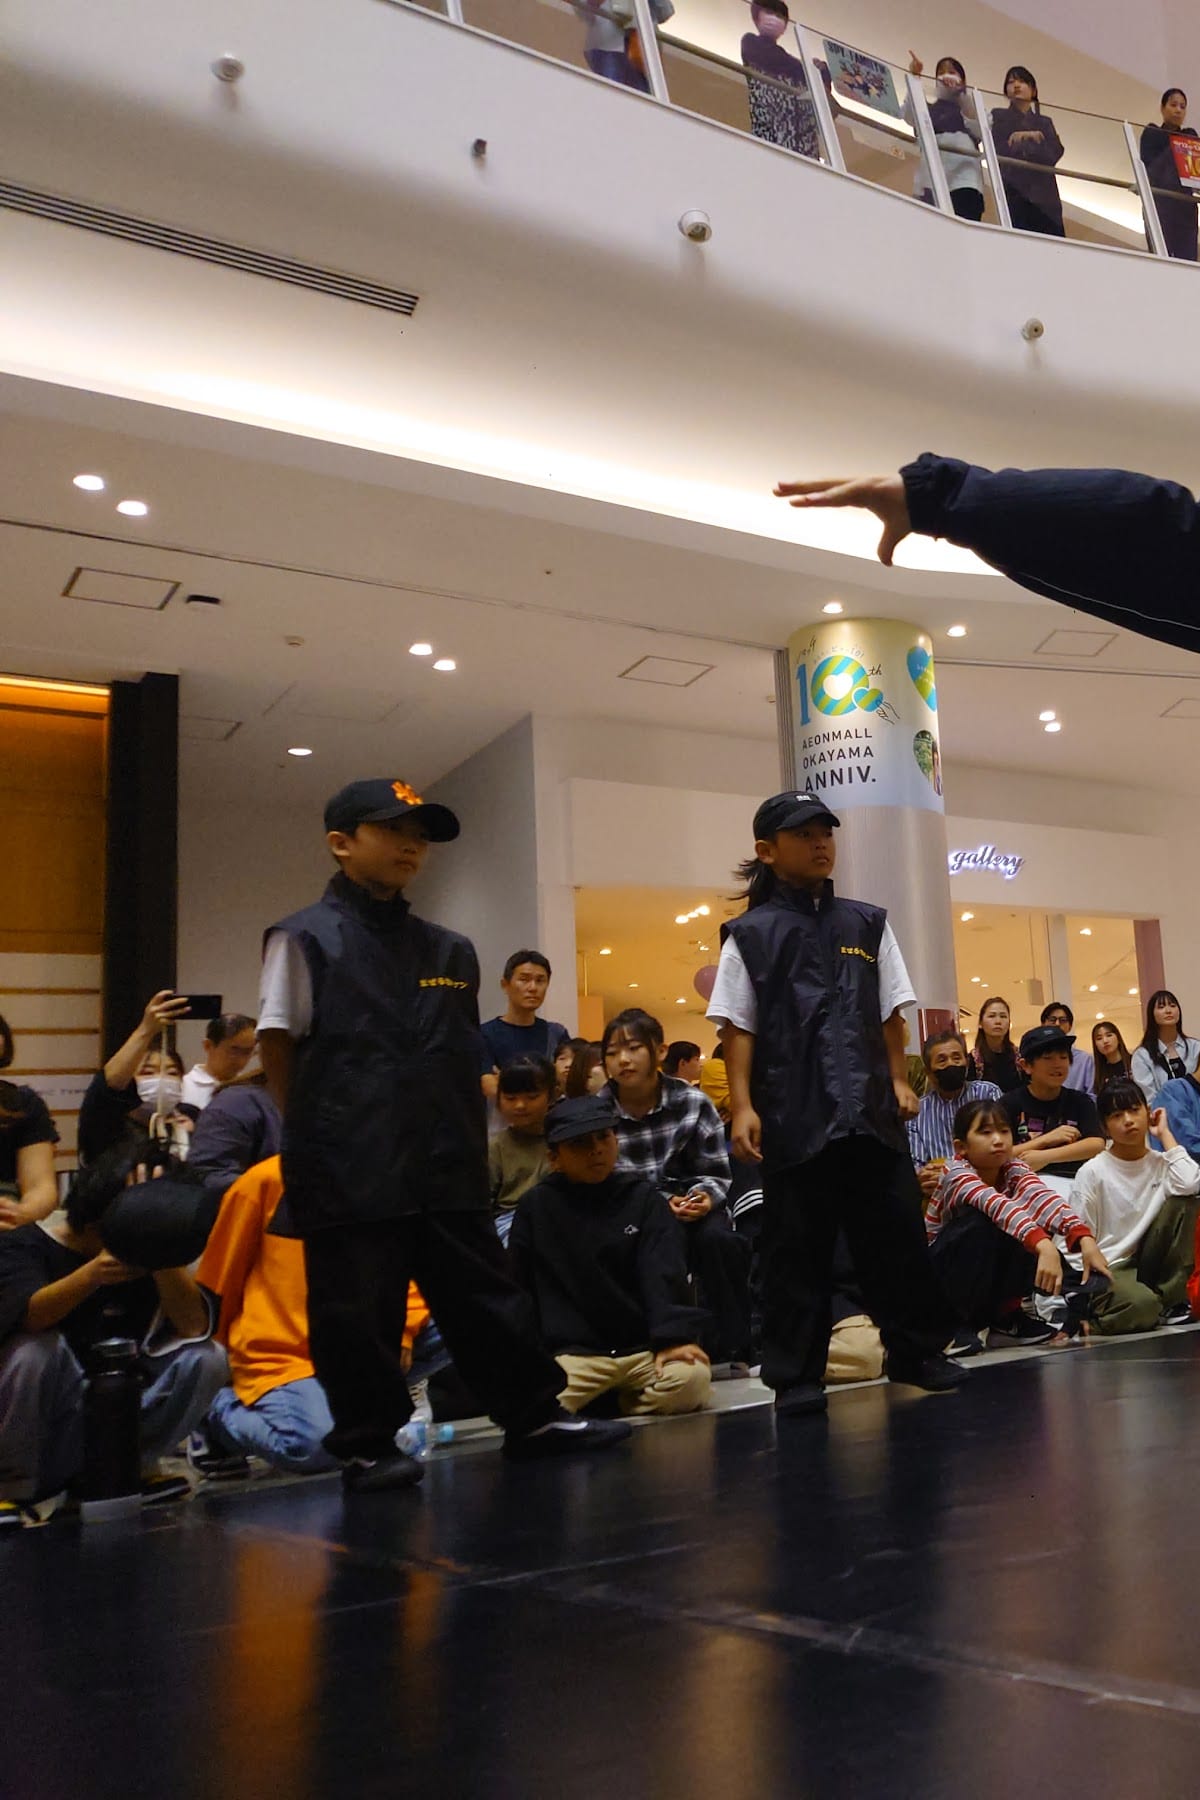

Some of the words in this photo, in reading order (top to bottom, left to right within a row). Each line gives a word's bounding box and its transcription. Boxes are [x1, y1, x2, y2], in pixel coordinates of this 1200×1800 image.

[802, 727, 873, 751] AEONMALL
[802, 745, 874, 770] OKAYAMA
[805, 765, 877, 793] ANNIV.
[951, 846, 1026, 876] gallery
